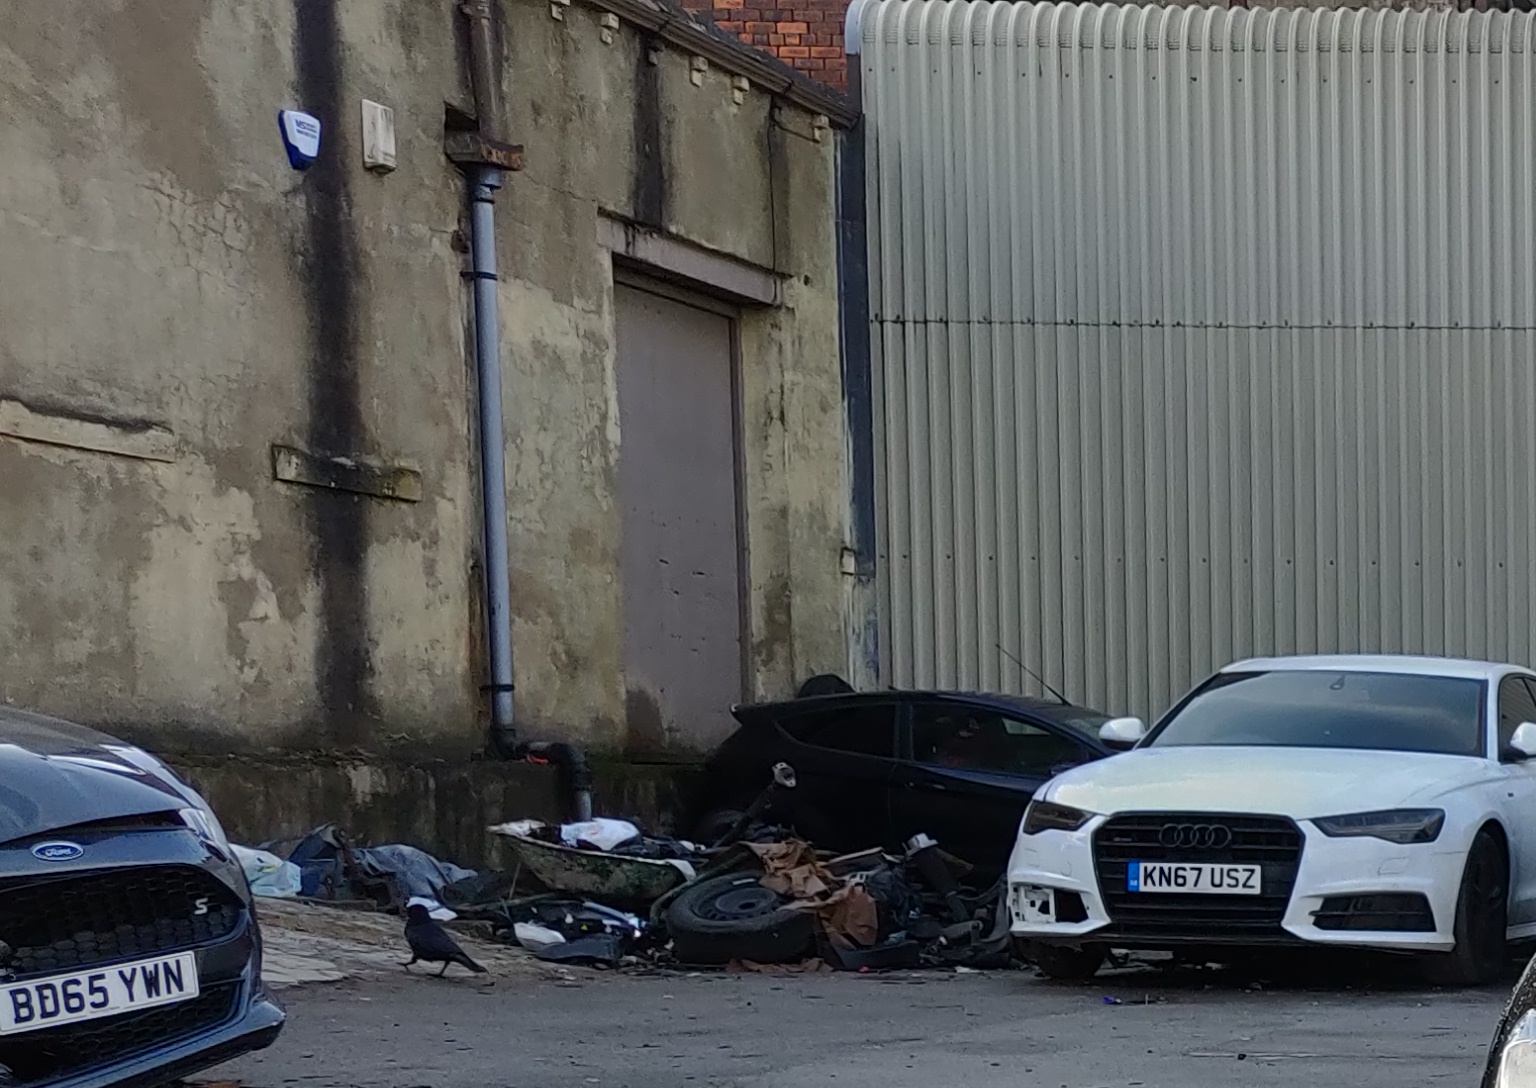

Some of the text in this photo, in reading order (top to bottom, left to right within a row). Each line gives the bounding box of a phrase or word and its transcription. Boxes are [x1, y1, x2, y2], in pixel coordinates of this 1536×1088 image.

[1143, 866, 1256, 889] KN67 USZ
[194, 898, 209, 915] S
[9, 959, 184, 1024] BD65 YWN
